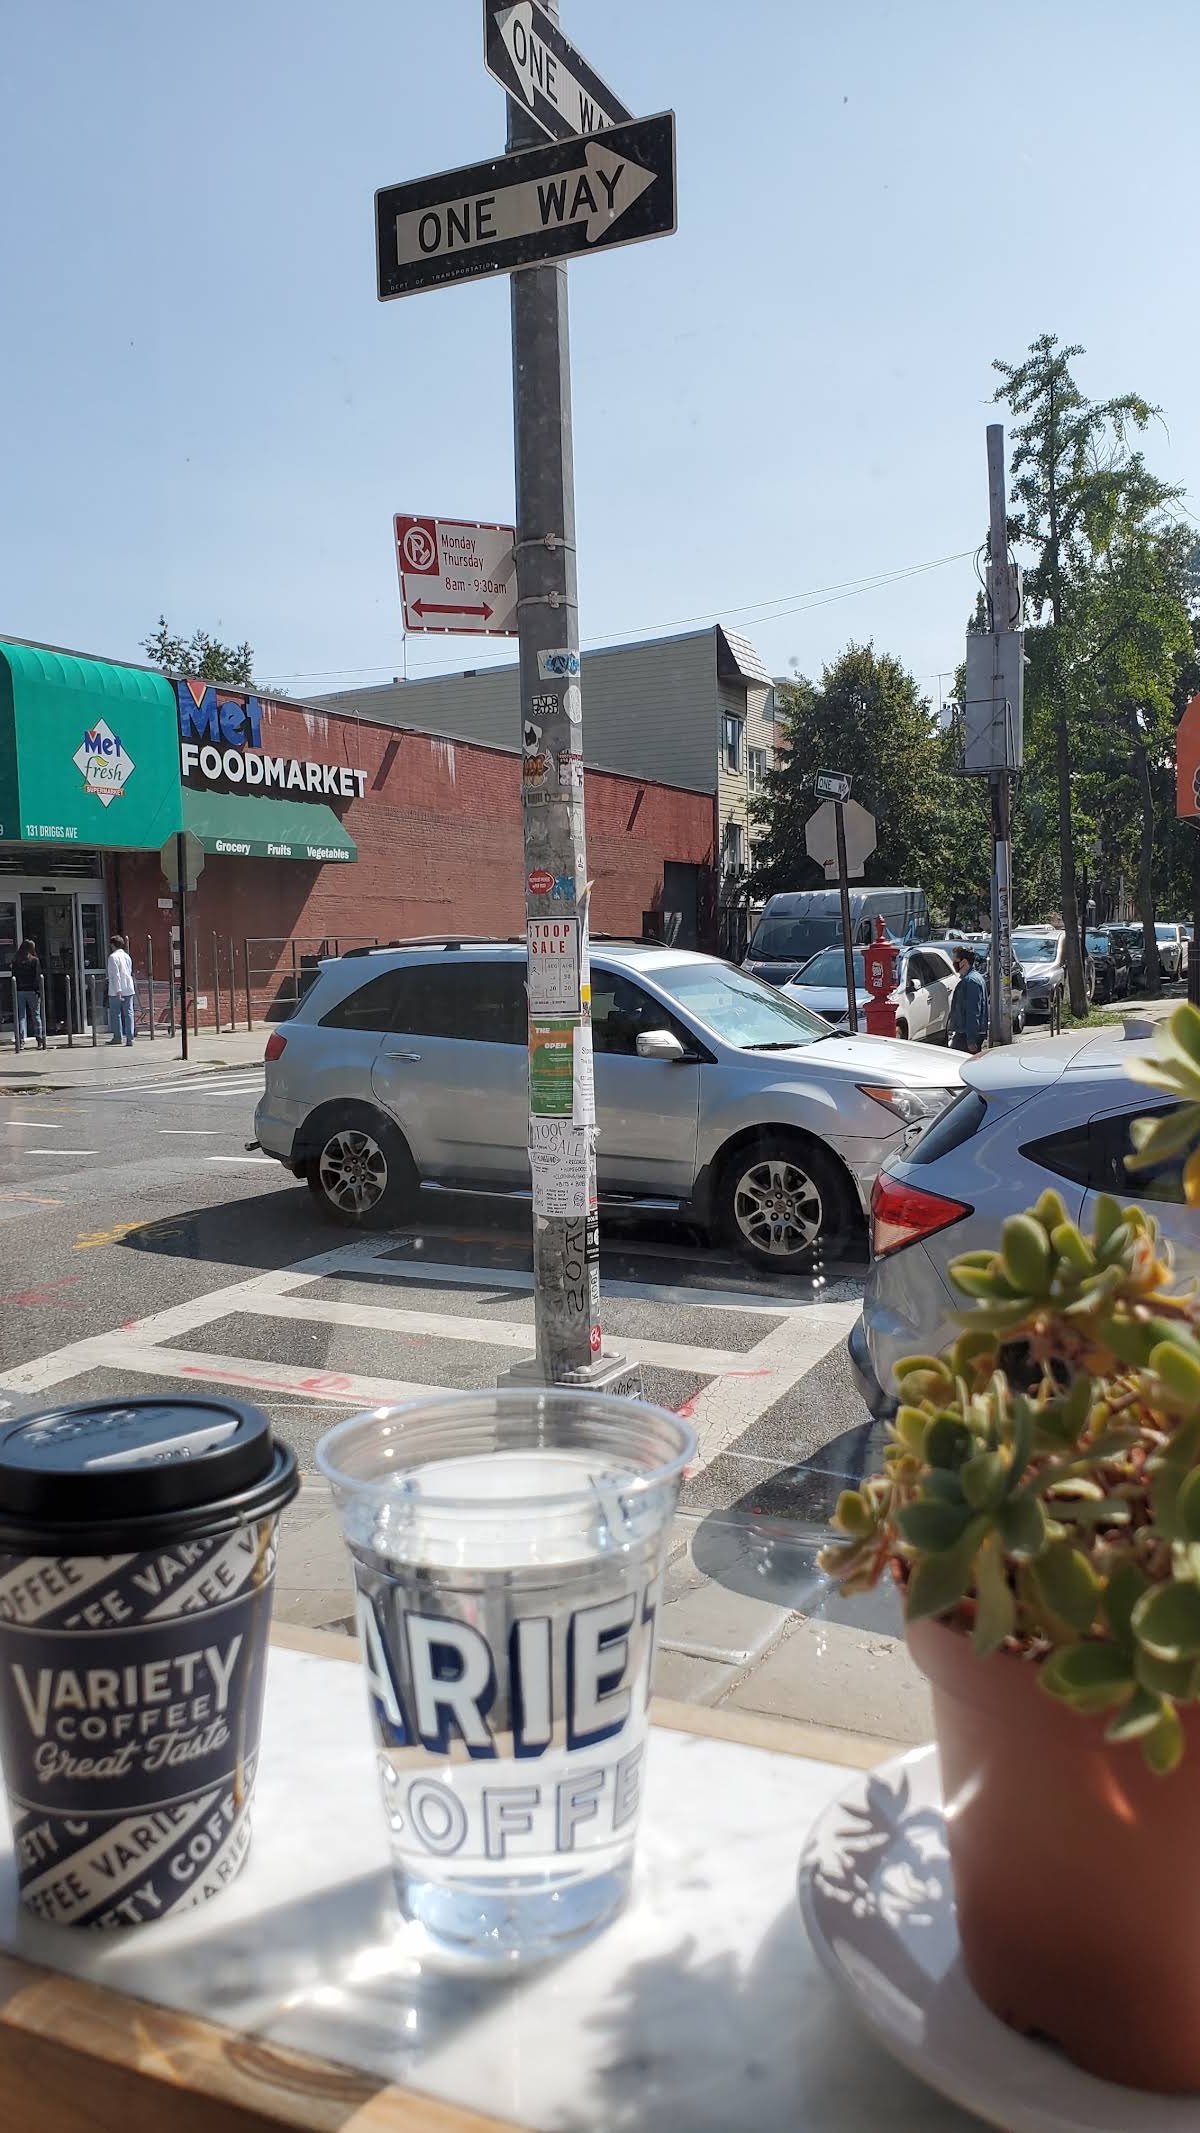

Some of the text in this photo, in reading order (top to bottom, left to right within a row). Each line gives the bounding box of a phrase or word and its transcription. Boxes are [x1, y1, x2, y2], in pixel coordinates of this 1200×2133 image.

[513, 19, 558, 105] ONE
[417, 163, 625, 254] ONE WAY
[390, 281, 409, 291] DEPT
[441, 533, 476, 554] Monday
[442, 551, 484, 572] Thursday
[445, 577, 466, 593] 8am
[474, 578, 507, 595] 9:30am
[177, 680, 263, 749] Met
[83, 730, 122, 757] Met
[82, 755, 124, 787] fresh
[181, 742, 368, 799] FOODMARKET
[86, 785, 125, 796] SUPERMARKET
[26, 824, 78, 839] 131 DRIGGS AVE
[215, 839, 350, 860] Grocery Fruits Vegetables
[532, 940, 566, 954] SALE
[11, 1632, 244, 1739] VARIETY
[55, 1693, 212, 1741] COFFEE
[141, 1715, 231, 1773] Taste
[34, 1738, 141, 1785] Great
